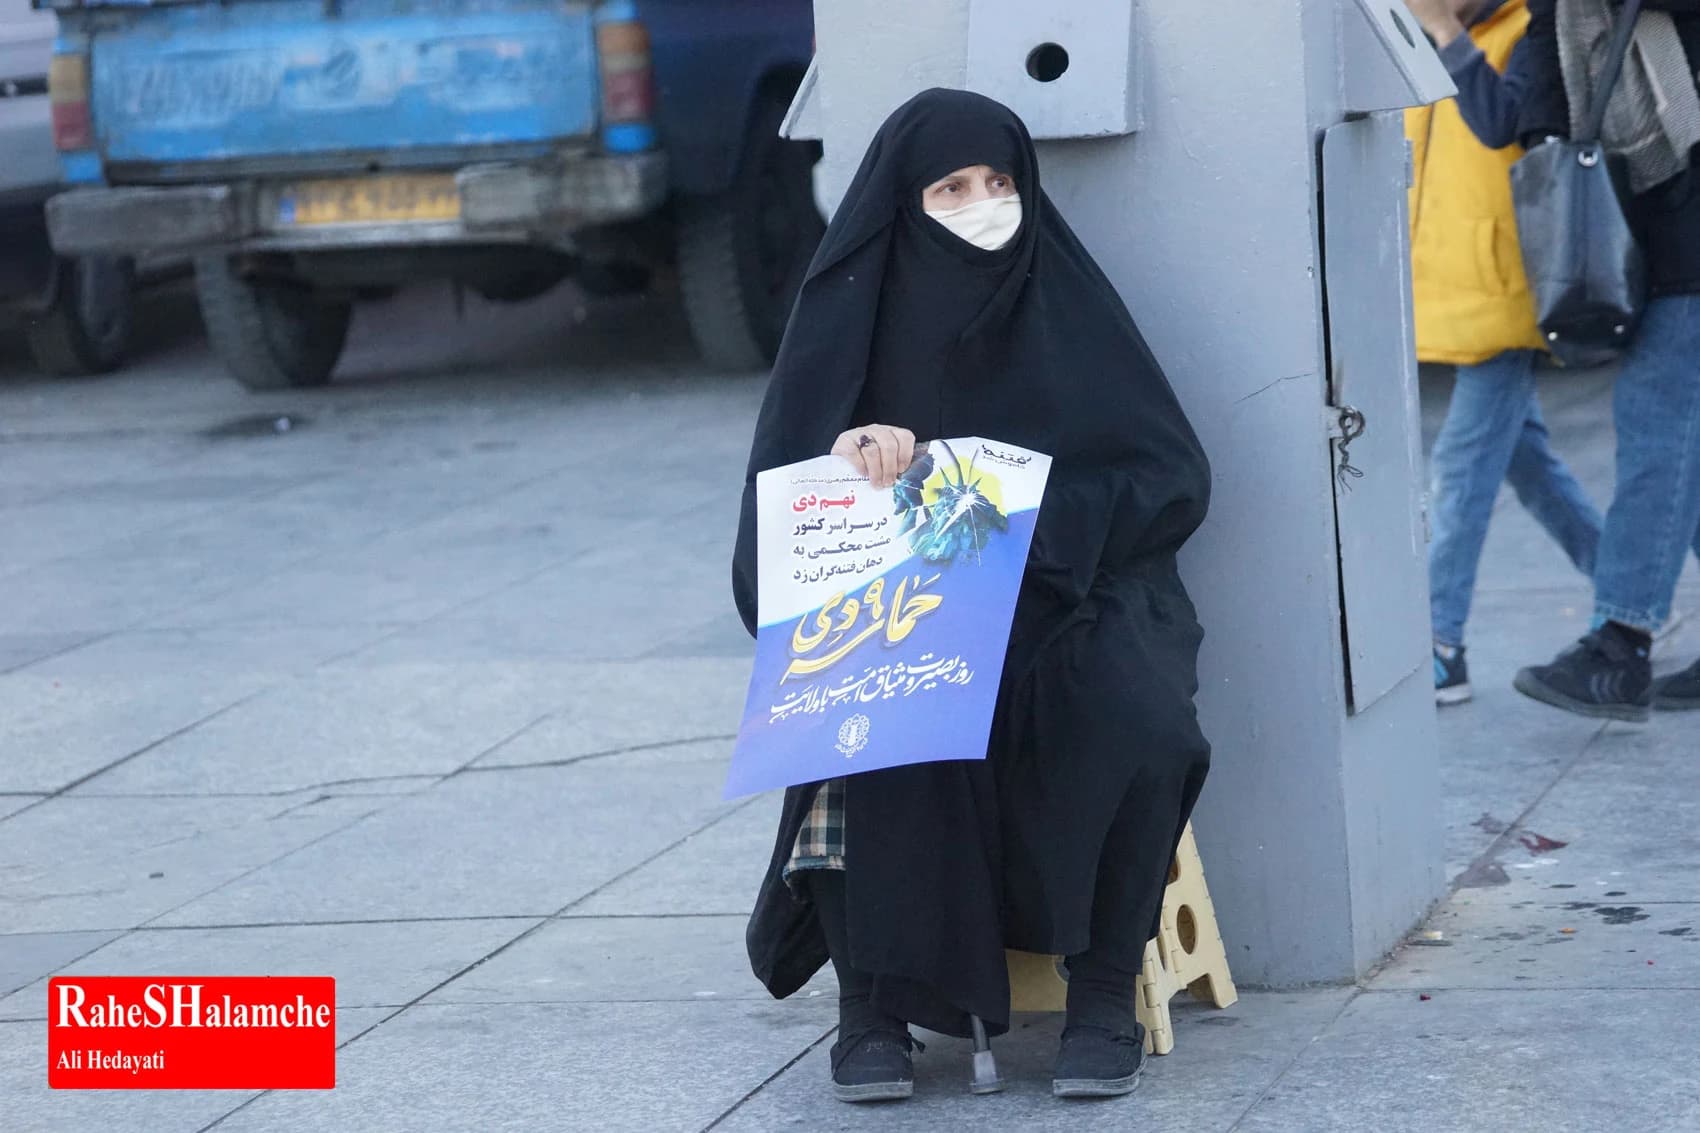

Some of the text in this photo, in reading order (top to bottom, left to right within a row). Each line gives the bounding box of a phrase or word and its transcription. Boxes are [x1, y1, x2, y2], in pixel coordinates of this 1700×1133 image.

[792, 489, 856, 512] نهم دی
[793, 517, 888, 536] در سراسر کشور
[793, 535, 892, 559] مشت محکمی به
[793, 568, 808, 584] زد
[856, 556, 883, 574] دهان
[792, 590, 860, 653] دی
[904, 652, 960, 696] بصیرت
[949, 661, 975, 685] روز
